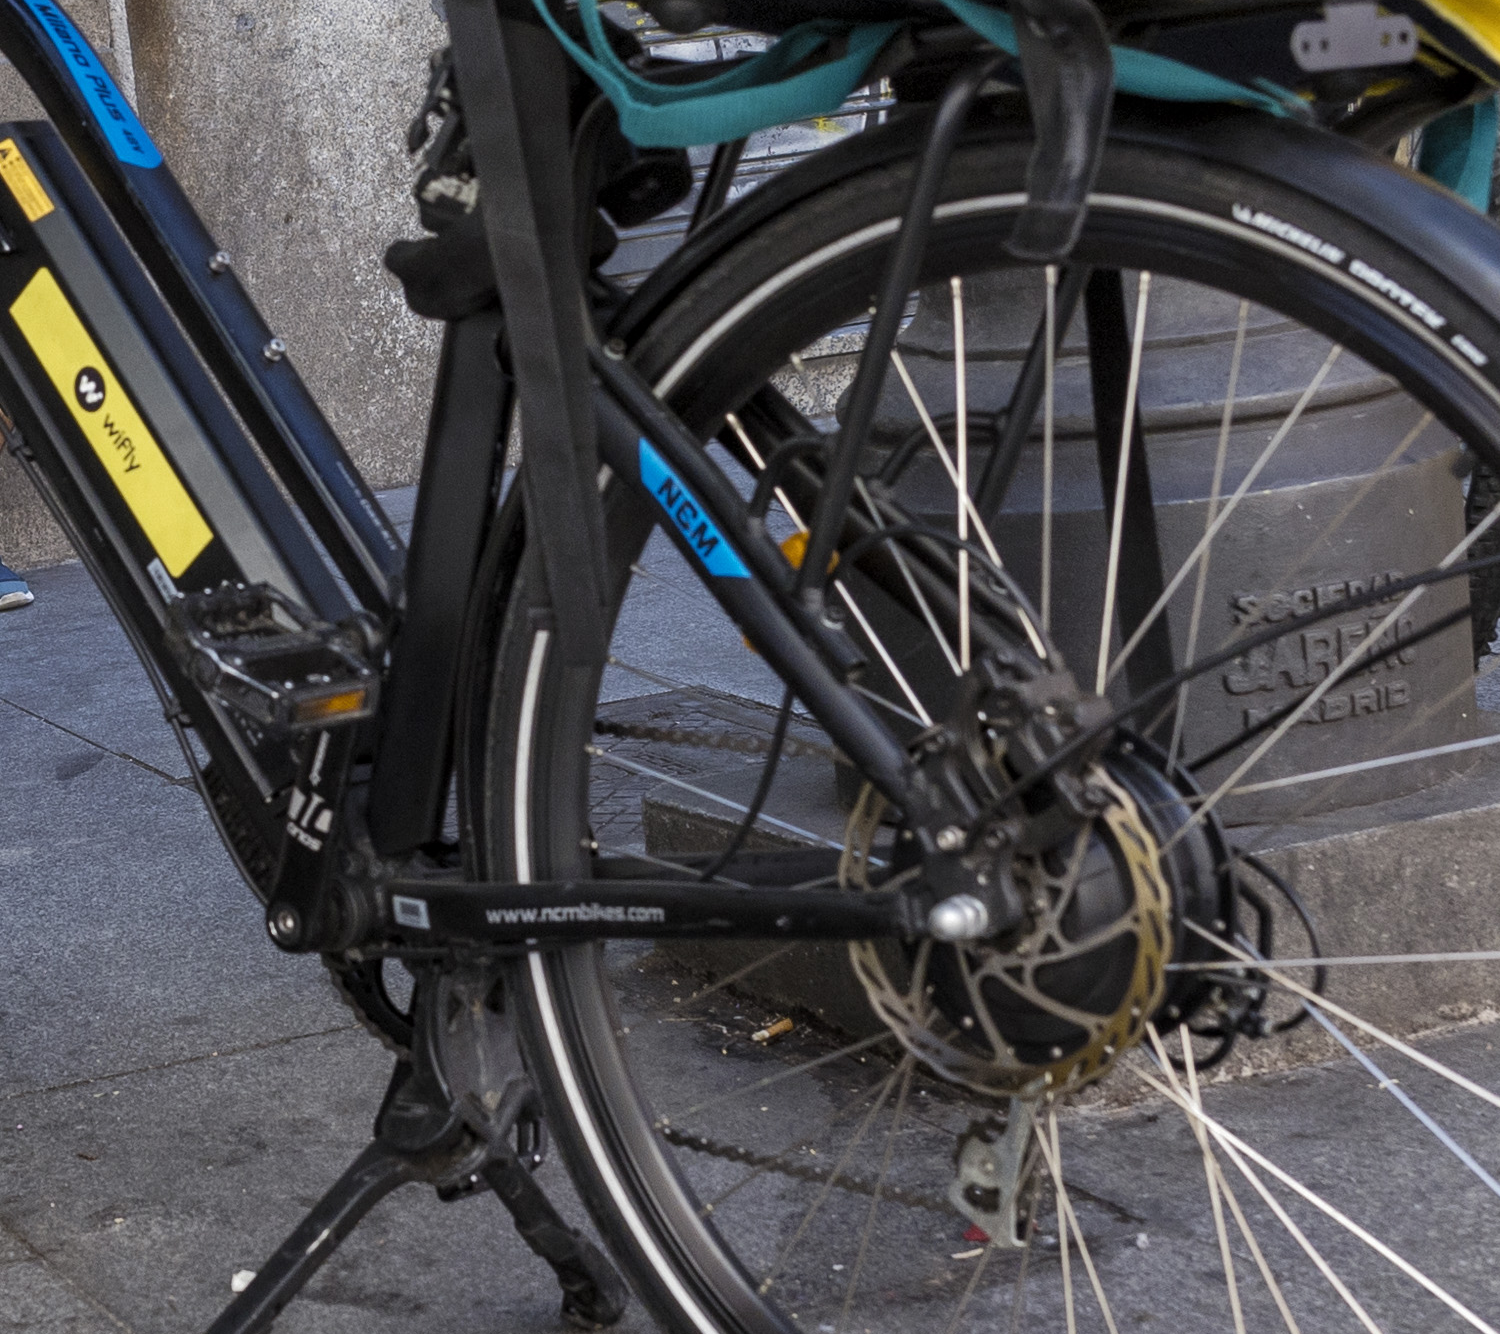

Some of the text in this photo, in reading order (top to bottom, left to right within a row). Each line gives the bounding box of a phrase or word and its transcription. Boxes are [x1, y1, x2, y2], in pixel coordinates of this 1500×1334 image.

[34, 1, 91, 69] Milano
[85, 71, 127, 123] Plus
[657, 476, 720, 558] NCM
